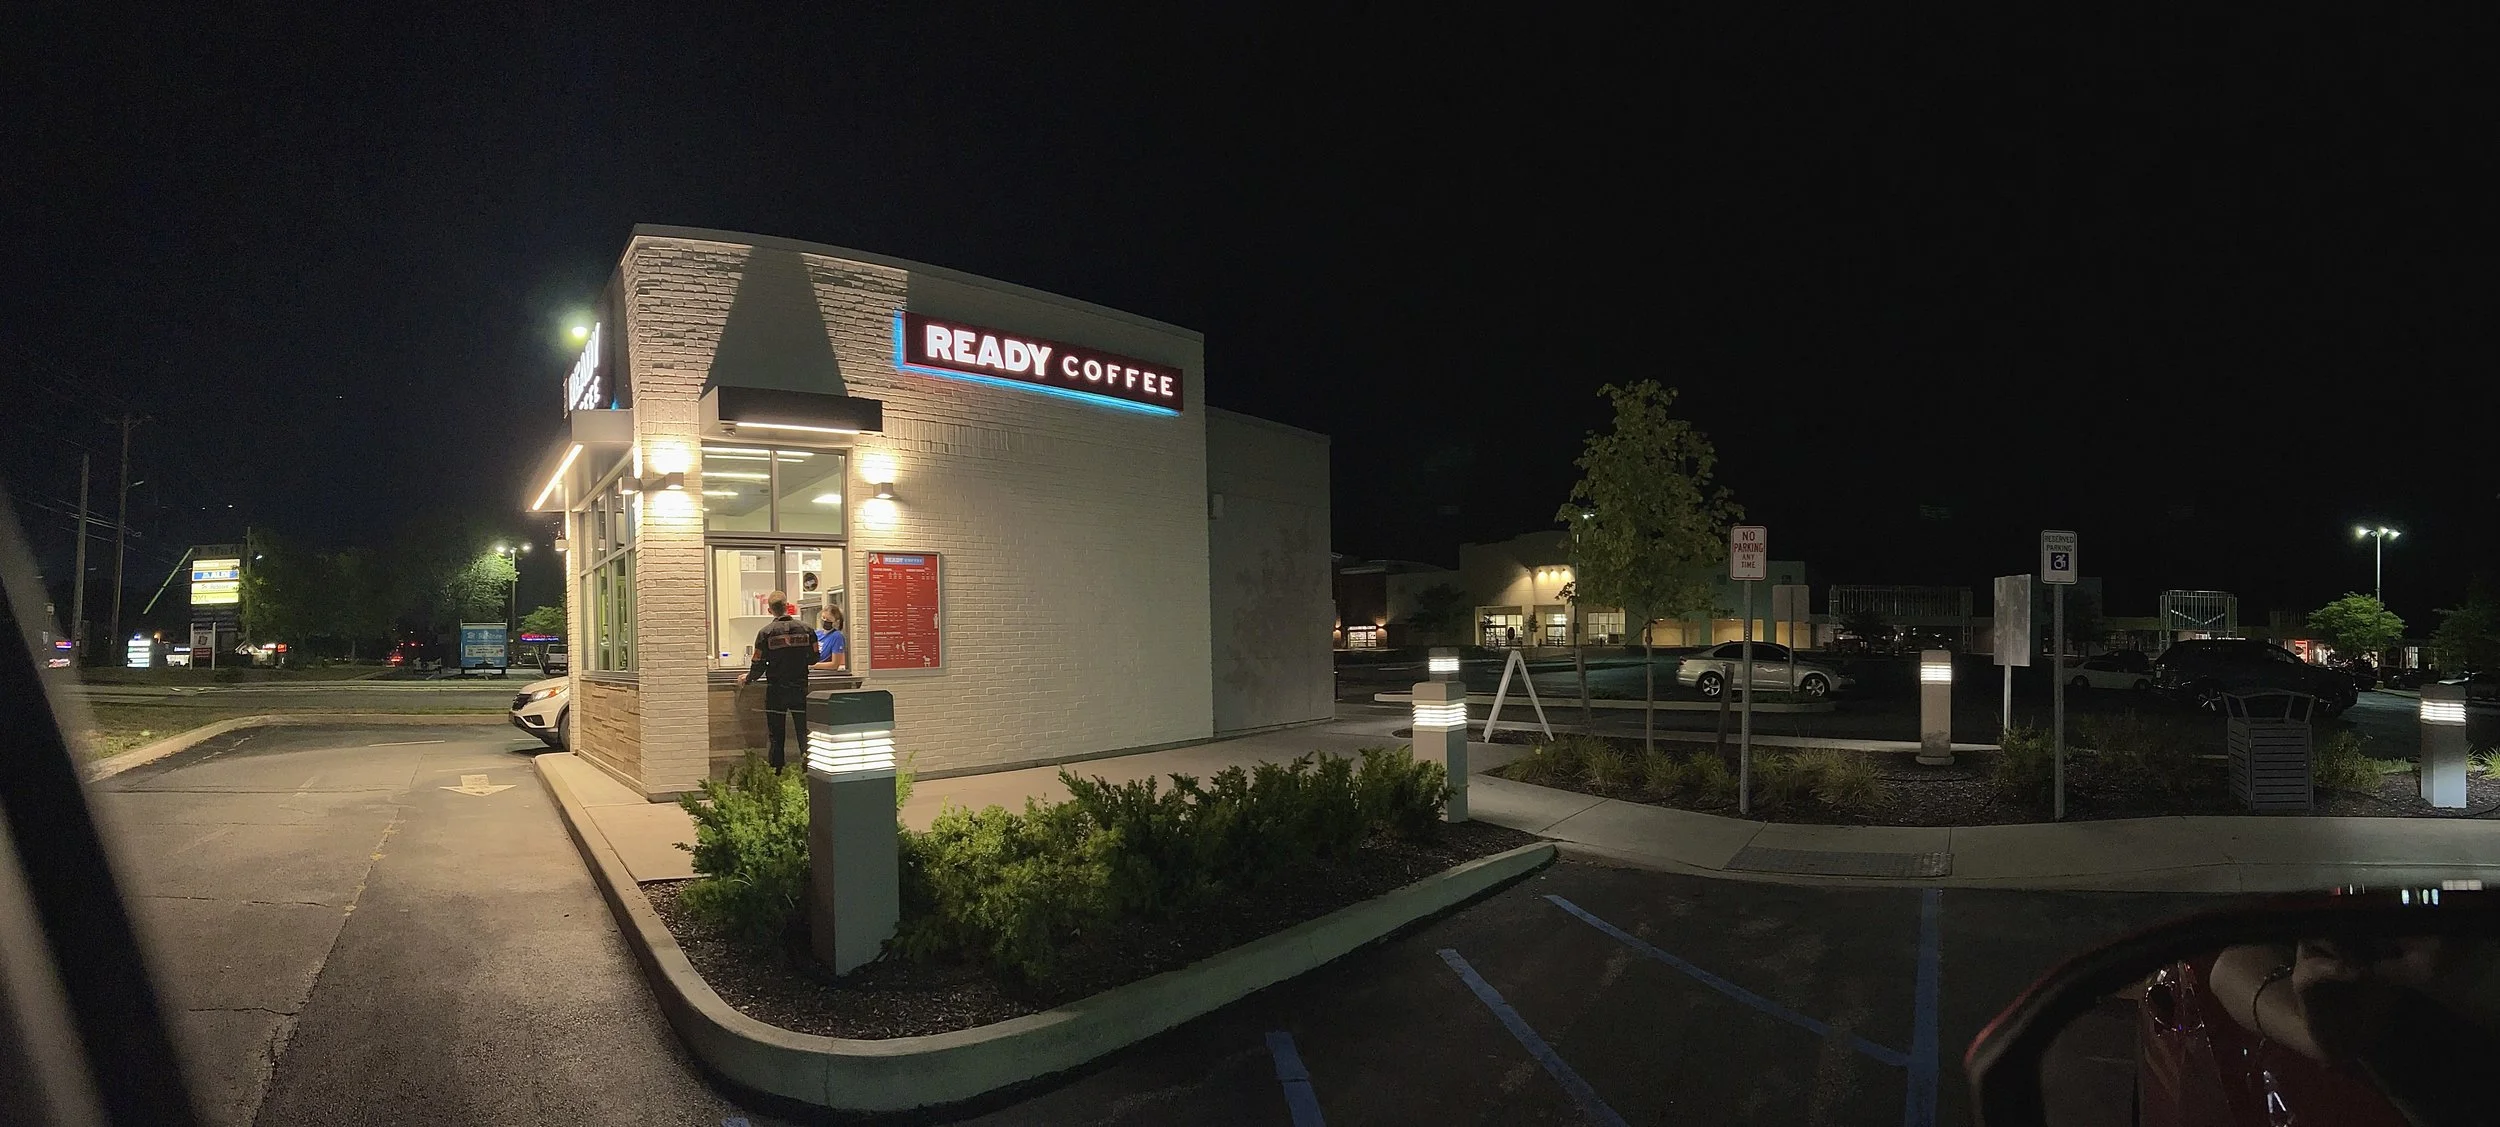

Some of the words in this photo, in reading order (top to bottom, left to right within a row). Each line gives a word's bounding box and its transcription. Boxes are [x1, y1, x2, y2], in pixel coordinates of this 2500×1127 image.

[926, 324, 1052, 376] READY
[1062, 355, 1174, 396] COFFEE
[1742, 531, 1755, 541] NO
[2045, 535, 2073, 543] RESERVED
[1733, 543, 1764, 553] PARKING
[2046, 544, 2073, 552] PARKING
[1741, 561, 1756, 569] TIME
